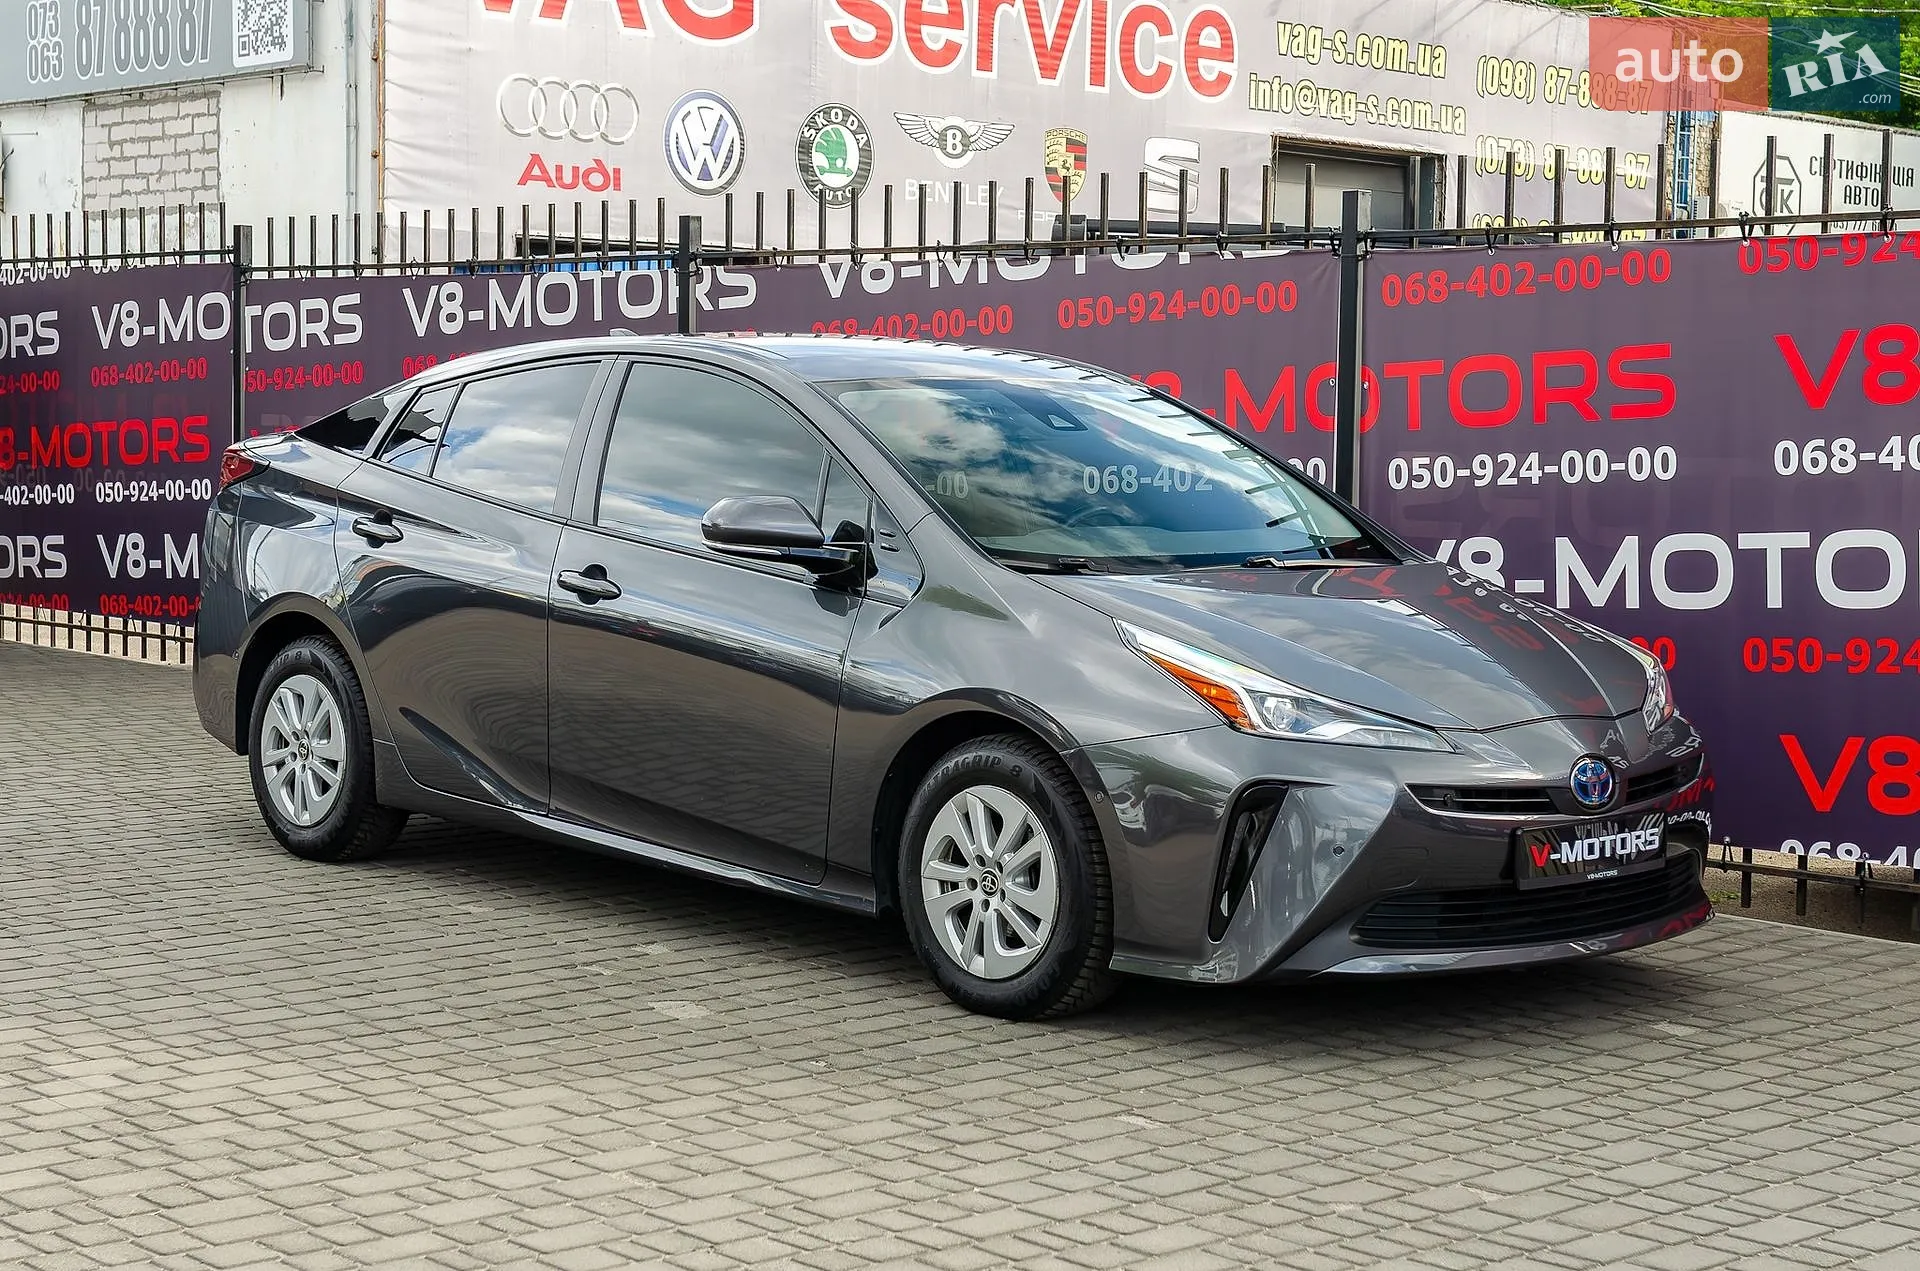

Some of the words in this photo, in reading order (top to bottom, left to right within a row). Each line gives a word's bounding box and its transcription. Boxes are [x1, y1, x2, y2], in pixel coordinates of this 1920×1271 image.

[26, 1, 60, 42] 073
[26, 40, 64, 84] 063
[823, 0, 1239, 102] service
[1277, 21, 1448, 79] vag-s.com.ua
[1476, 55, 1536, 104] (098)
[1249, 73, 1467, 136] info@vag-s.com.ua
[1046, 129, 1086, 142] PORSCHE
[517, 153, 621, 192] Audi
[1844, 185, 1879, 207] АВТО
[1381, 248, 1672, 306] 068-402-00-00
[1057, 280, 1297, 329] 050-924-00-00
[91, 358, 208, 388] 068-402-00-00
[244, 361, 364, 392] 50-924-00-00
[1388, 445, 1677, 489] 050-924-00-00
[96, 478, 212, 503] 050-924-00-00
[1530, 828, 1660, 867] V-MOTORS
